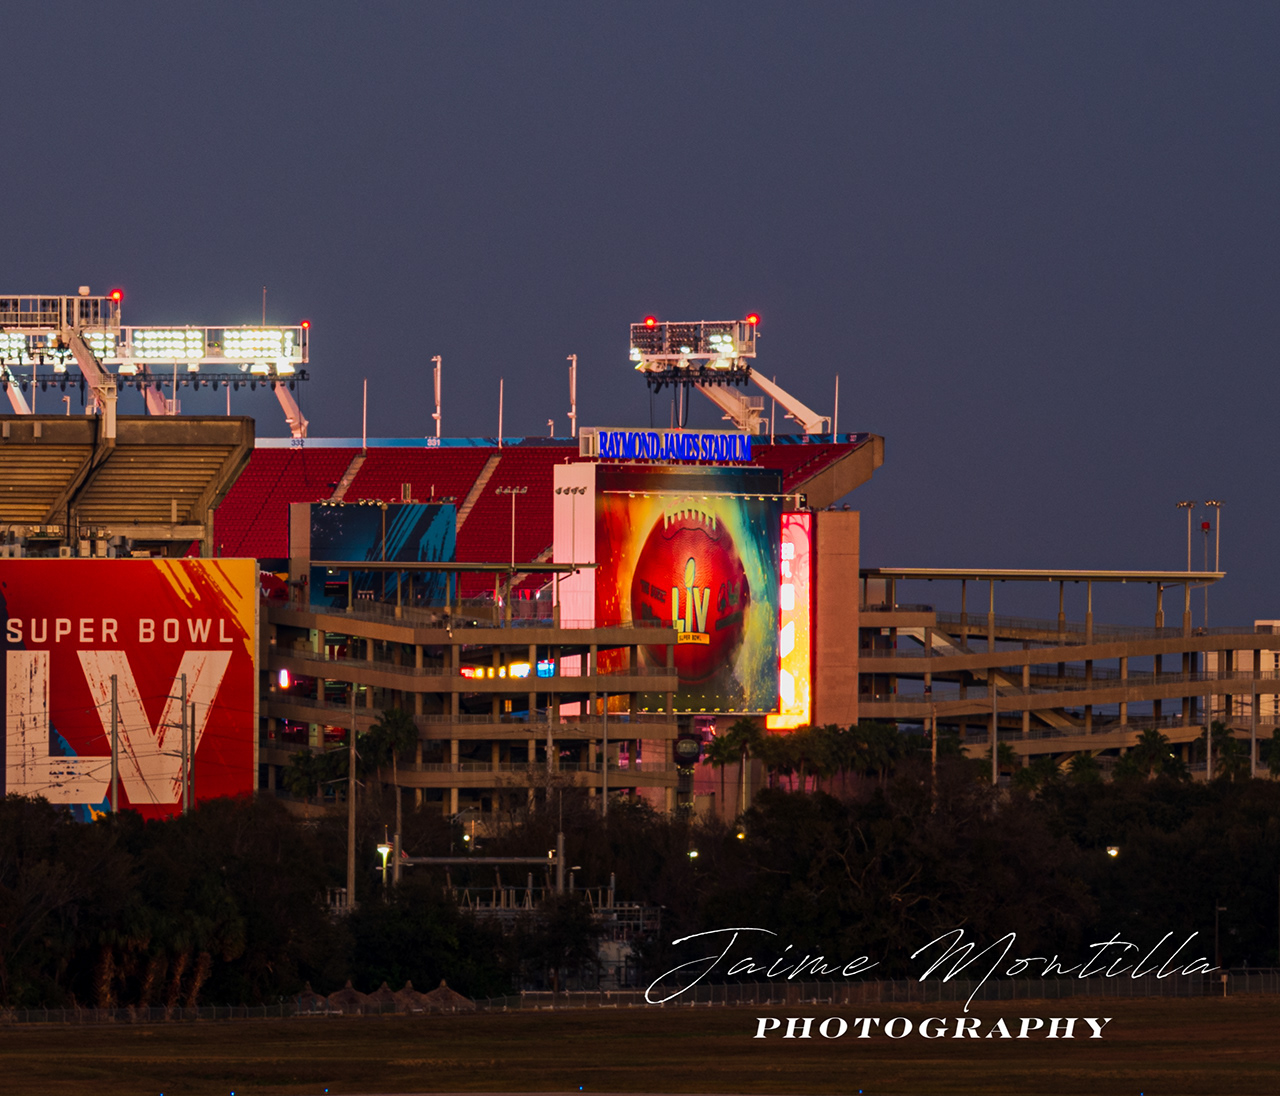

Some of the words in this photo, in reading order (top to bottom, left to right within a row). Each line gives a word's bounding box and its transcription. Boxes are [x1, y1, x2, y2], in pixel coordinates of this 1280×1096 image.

[599, 432, 660, 458] RAYMOND
[660, 433, 700, 460] JAMES
[701, 434, 752, 461] STADIUM
[6, 618, 118, 643] SUPER
[139, 618, 233, 643] BOWL
[6, 650, 233, 804] LV
